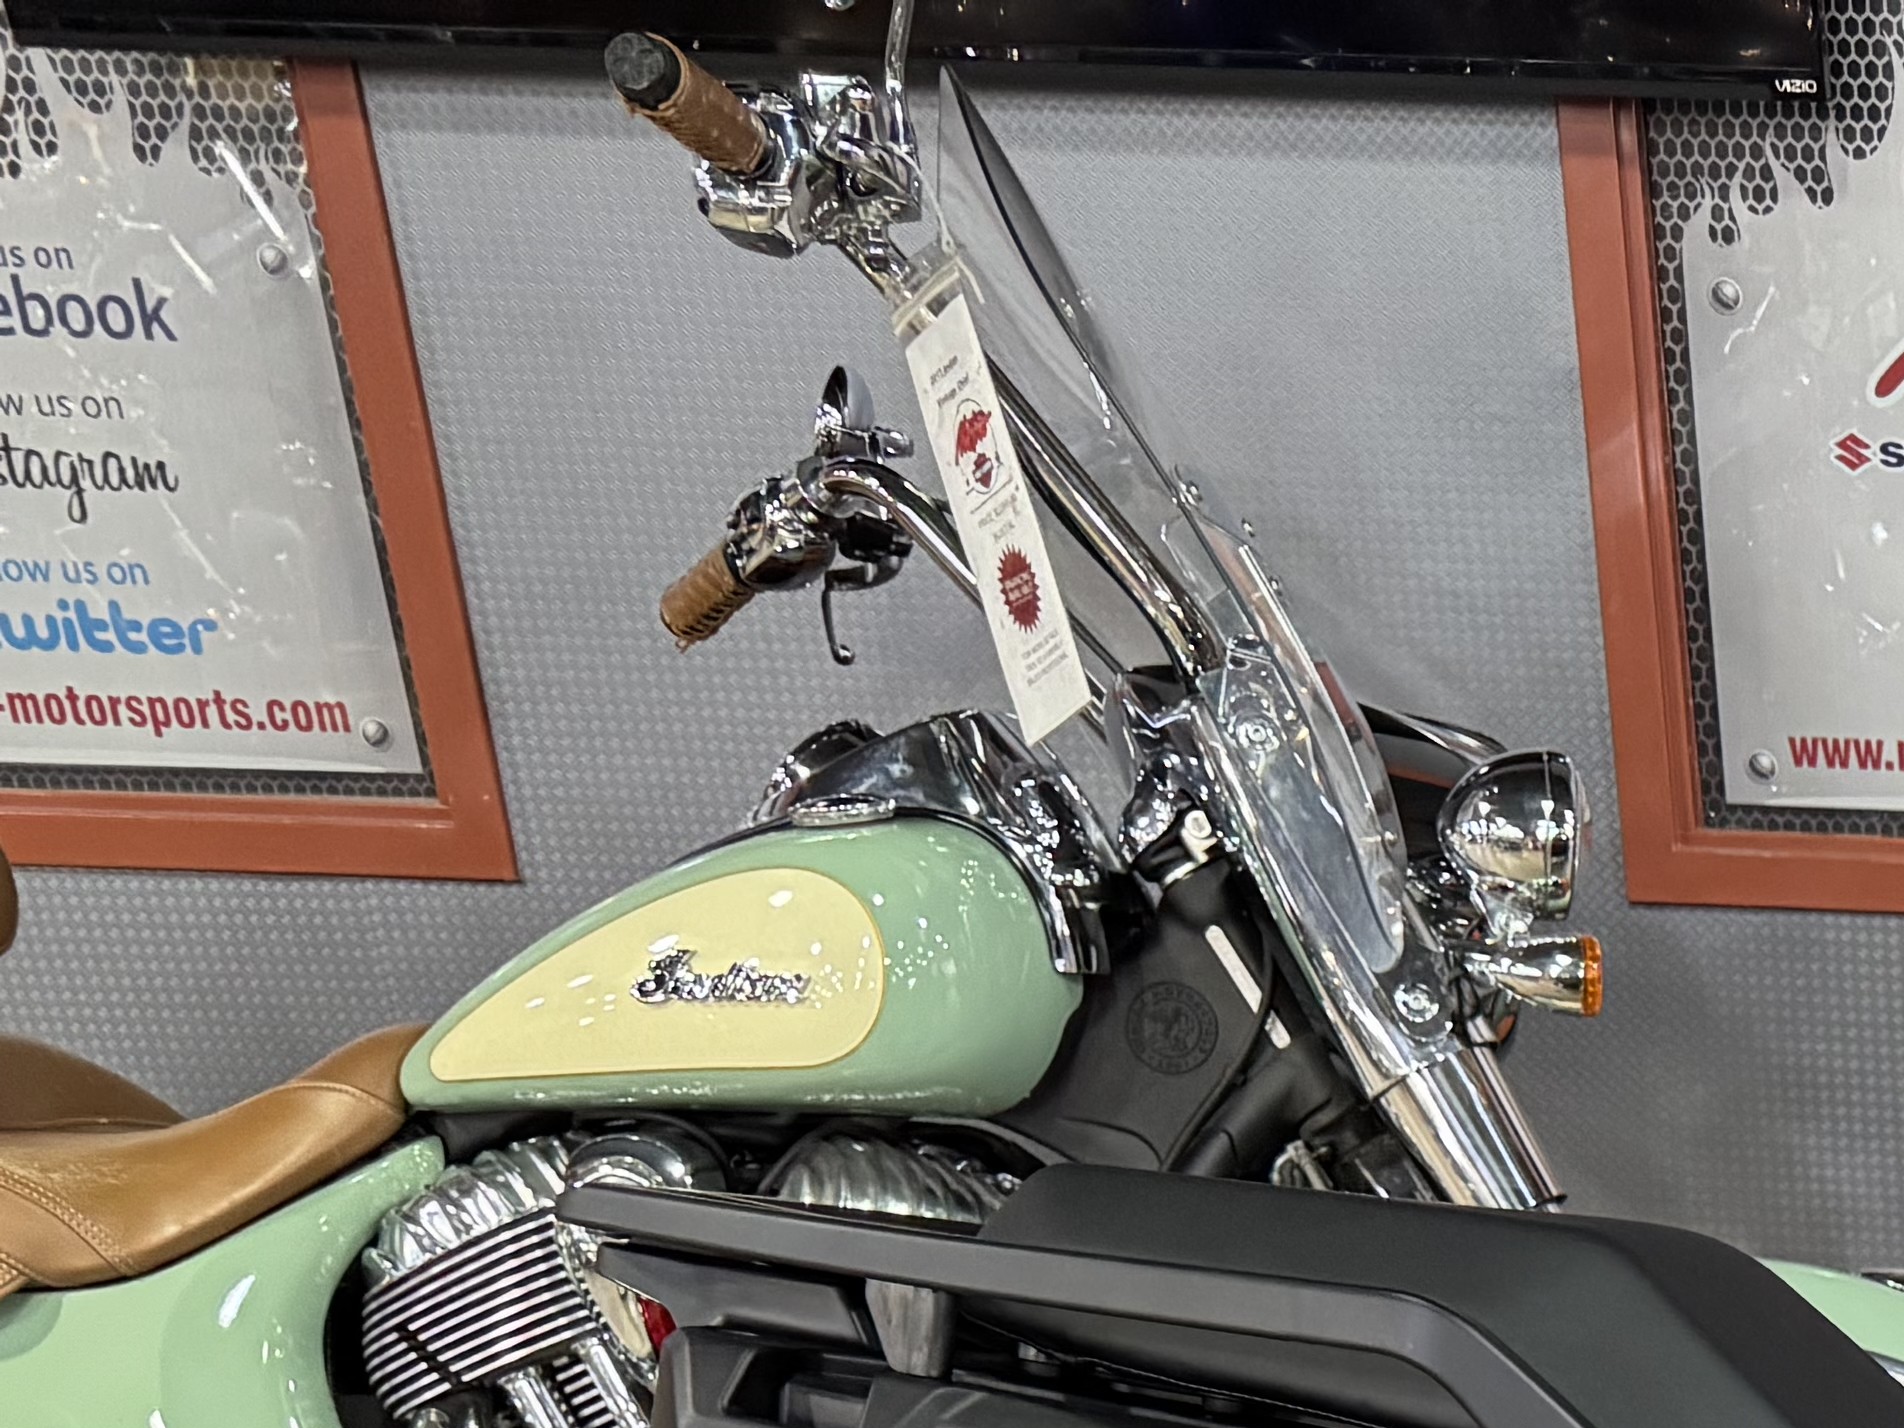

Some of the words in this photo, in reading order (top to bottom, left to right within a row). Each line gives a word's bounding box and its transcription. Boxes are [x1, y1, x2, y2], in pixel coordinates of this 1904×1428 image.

[1774, 78, 1818, 94] VIZIO
[34, 245, 75, 270] on
[34, 392, 74, 419] us
[80, 392, 126, 421] on
[0, 431, 180, 524] tagram
[60, 559, 100, 584] us
[106, 562, 151, 588] on
[0, 597, 219, 656] witter
